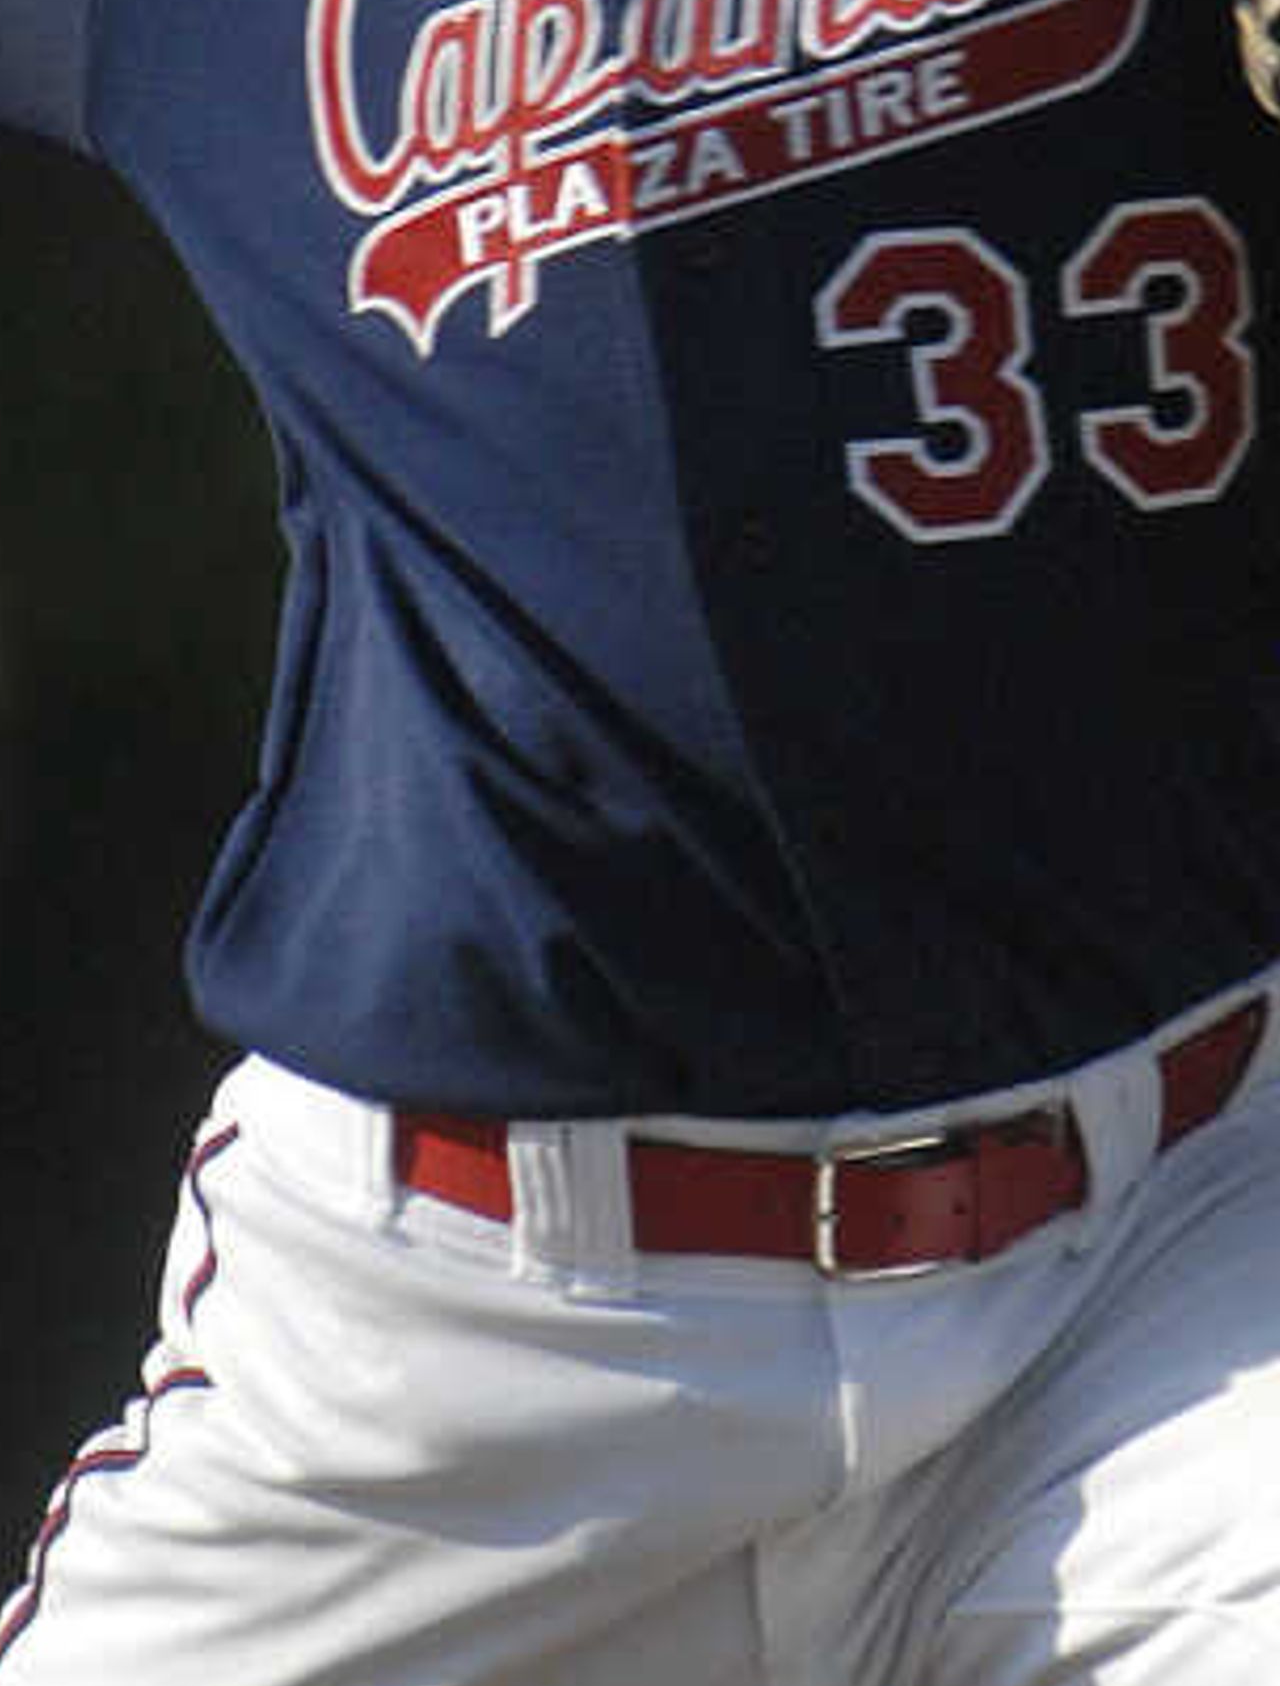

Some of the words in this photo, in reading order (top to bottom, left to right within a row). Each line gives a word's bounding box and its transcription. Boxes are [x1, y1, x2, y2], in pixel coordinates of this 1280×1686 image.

[455, 131, 744, 265] PLAZA
[771, 52, 969, 162] TIRE
[816, 198, 1254, 544] 33
